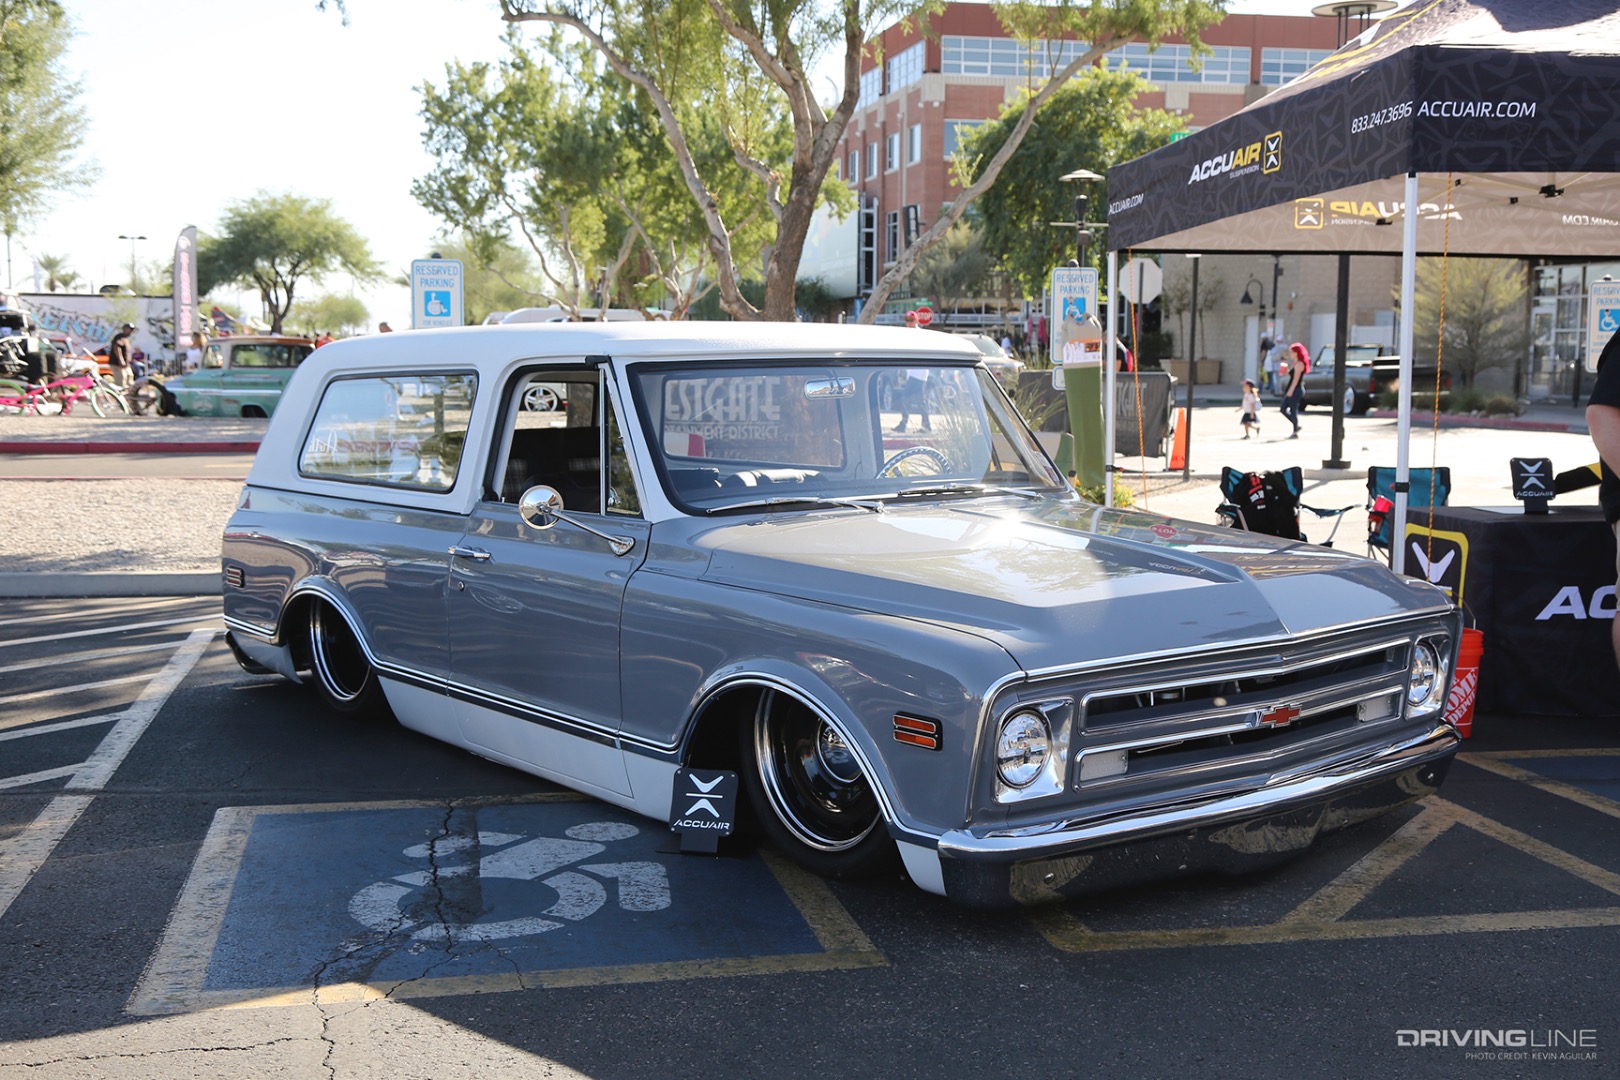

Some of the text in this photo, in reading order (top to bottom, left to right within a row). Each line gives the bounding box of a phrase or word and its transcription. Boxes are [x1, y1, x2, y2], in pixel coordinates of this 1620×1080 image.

[1417, 101, 1536, 118] ACCUAIR.COM
[1187, 142, 1262, 185] ACCUAIR
[1229, 164, 1260, 179] SUSPENSION
[1108, 193, 1144, 216] ACCUAIR.COM
[415, 265, 459, 276] RESERVED
[420, 277, 455, 288] PARKING
[1056, 273, 1094, 283] RESERVED
[1060, 285, 1090, 295] PARKING
[917, 311, 933, 320] STOP
[728, 424, 780, 441] DISTRICT
[1443, 668, 1476, 717] OME
[673, 819, 731, 830] ACCUAIR
